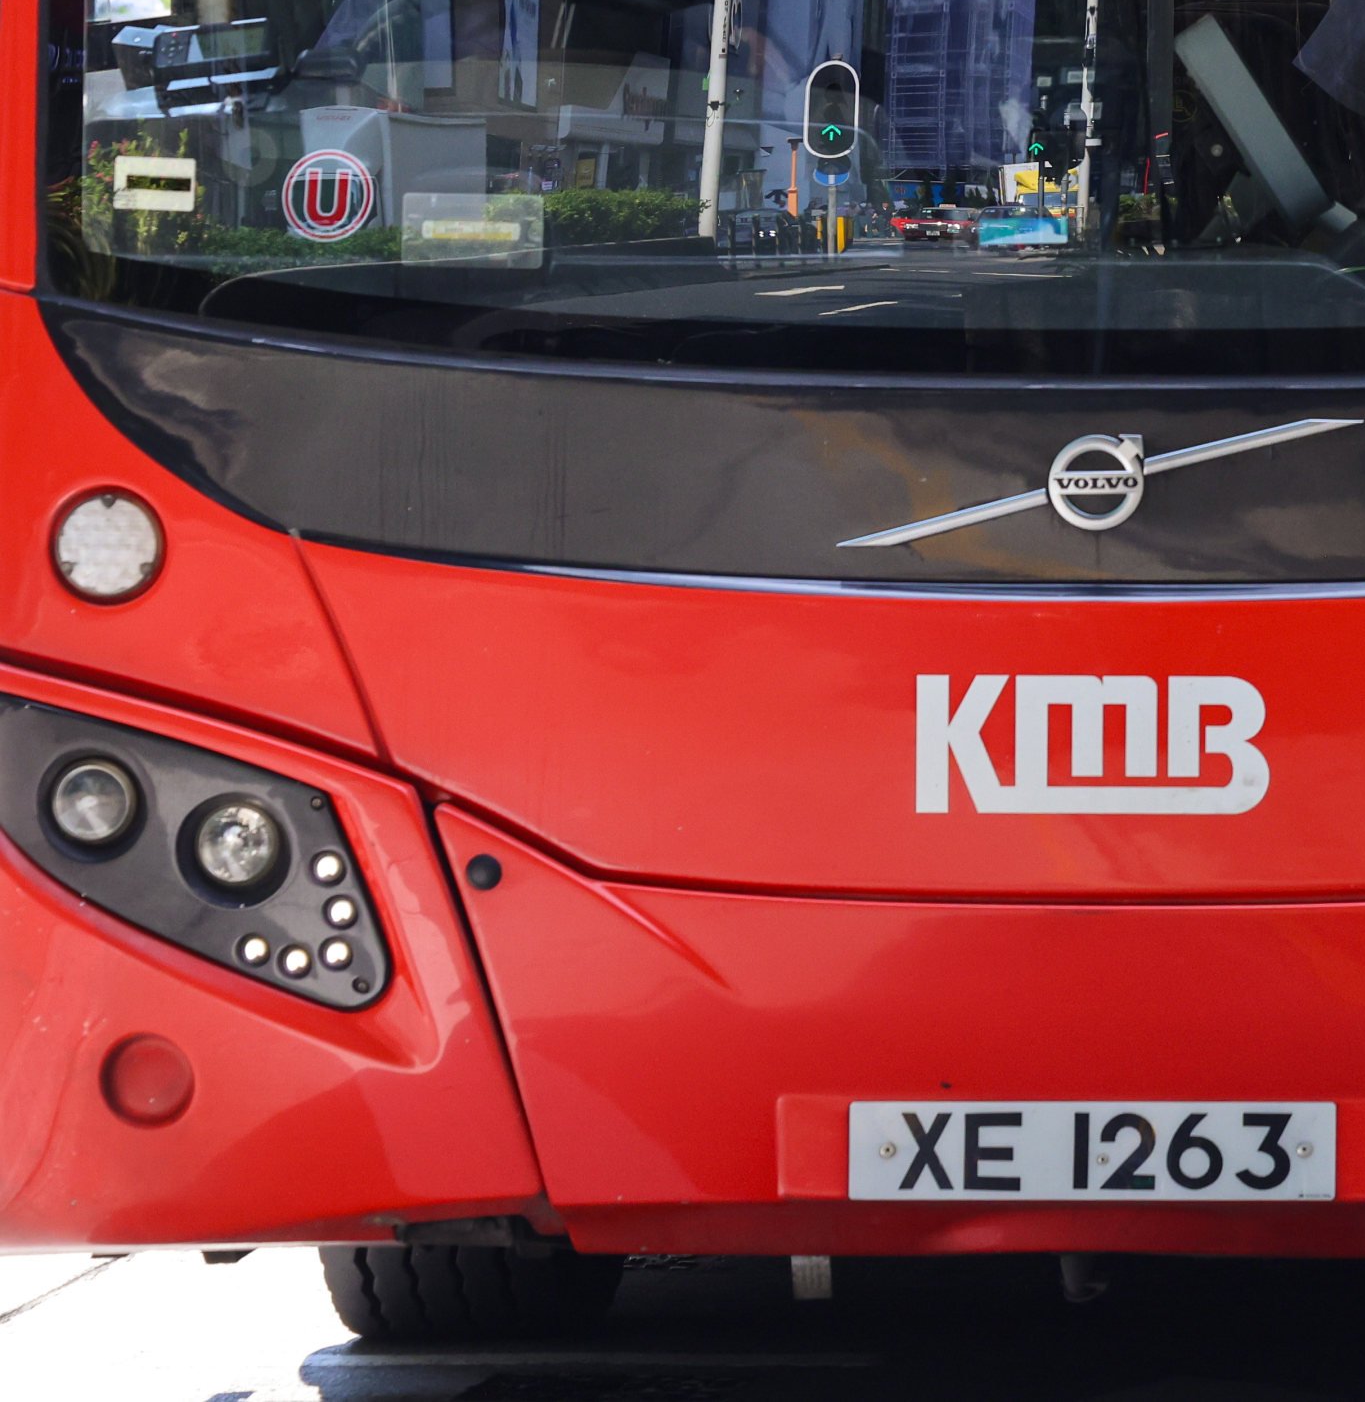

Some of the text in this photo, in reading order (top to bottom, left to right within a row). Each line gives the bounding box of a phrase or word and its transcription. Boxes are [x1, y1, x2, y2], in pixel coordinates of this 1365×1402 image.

[304, 168, 350, 229] U
[1053, 477, 1139, 491] VOLVO
[915, 674, 1270, 815] KMB
[898, 1111, 1293, 1192] XE 1263
